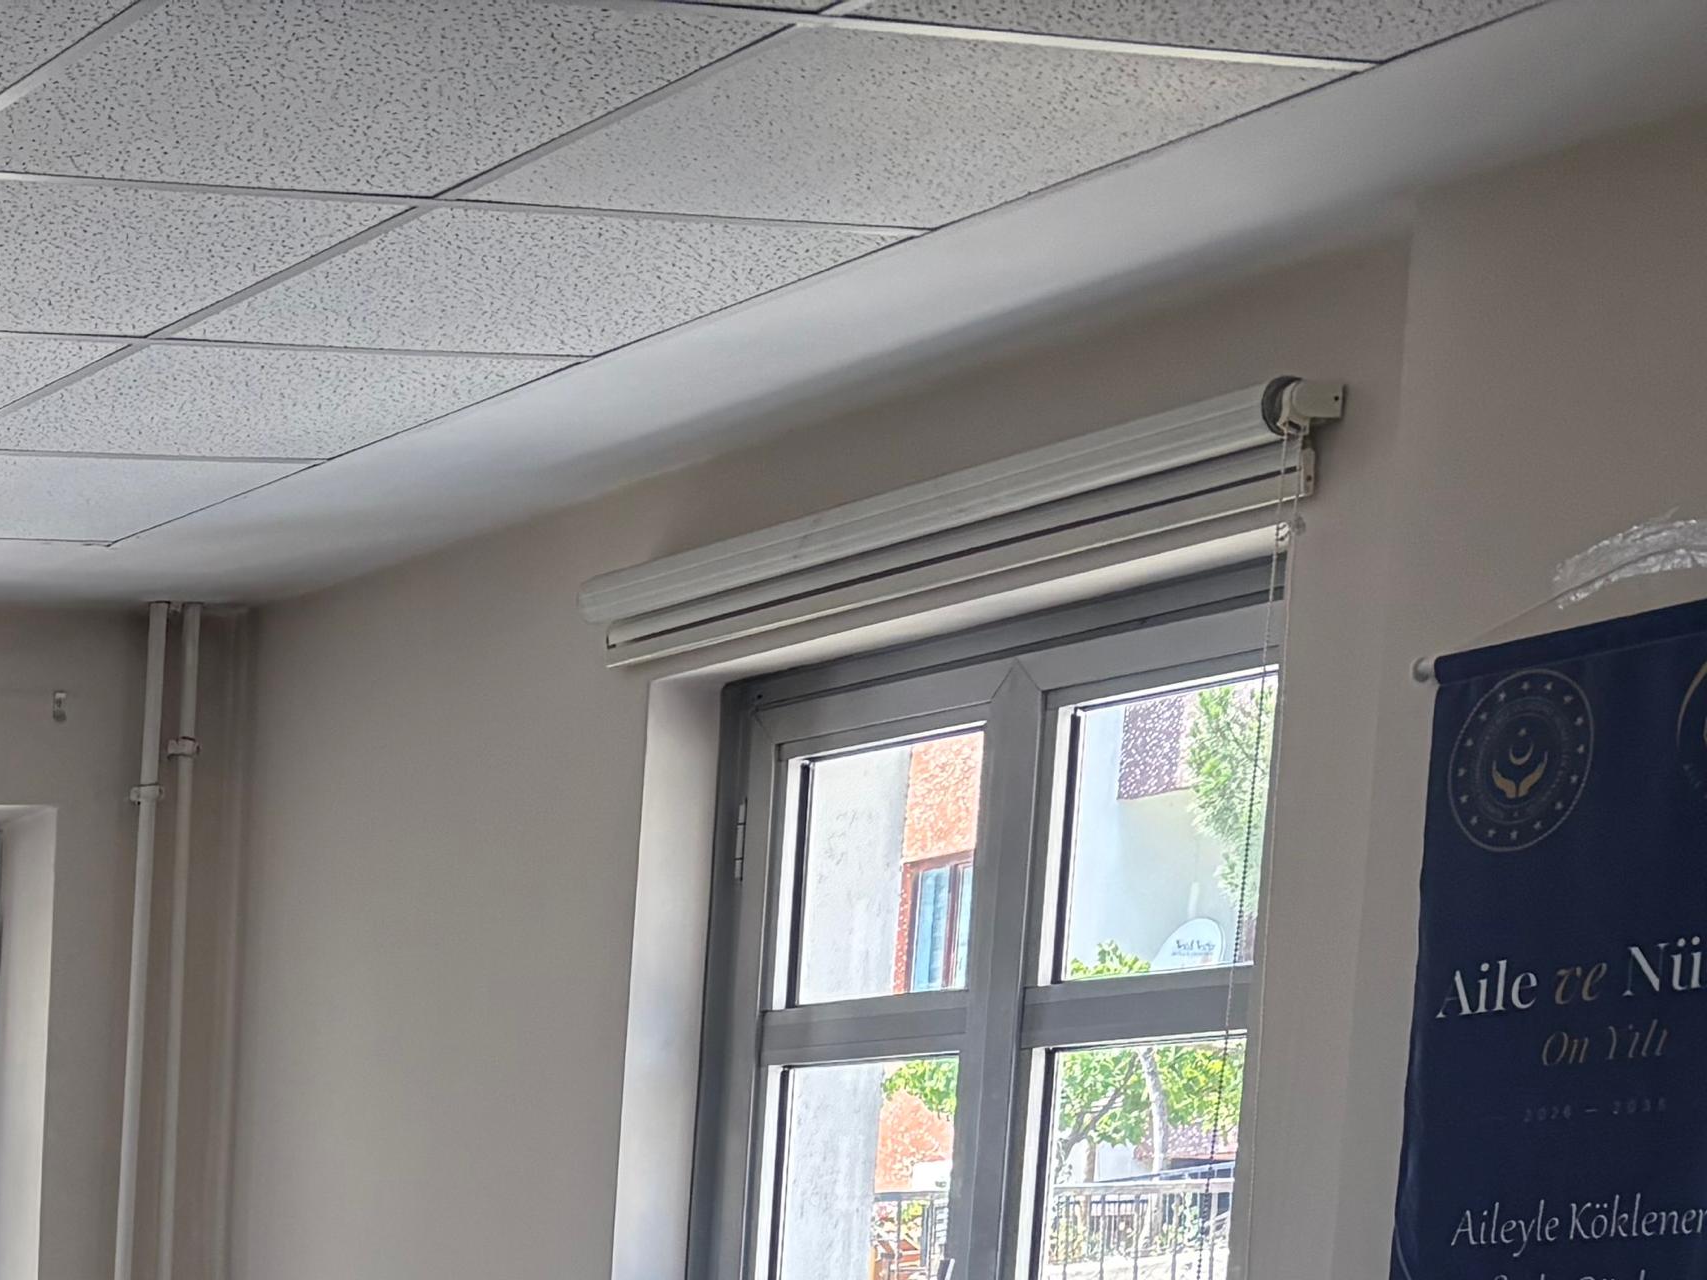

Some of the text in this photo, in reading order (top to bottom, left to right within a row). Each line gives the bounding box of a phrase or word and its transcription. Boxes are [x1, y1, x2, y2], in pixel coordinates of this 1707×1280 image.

[1435, 959, 1537, 1018] Aile
[1554, 962, 1608, 1005] ve
[1542, 1030, 1590, 1066] On
[1451, 1199, 1560, 1258] Aileyle
